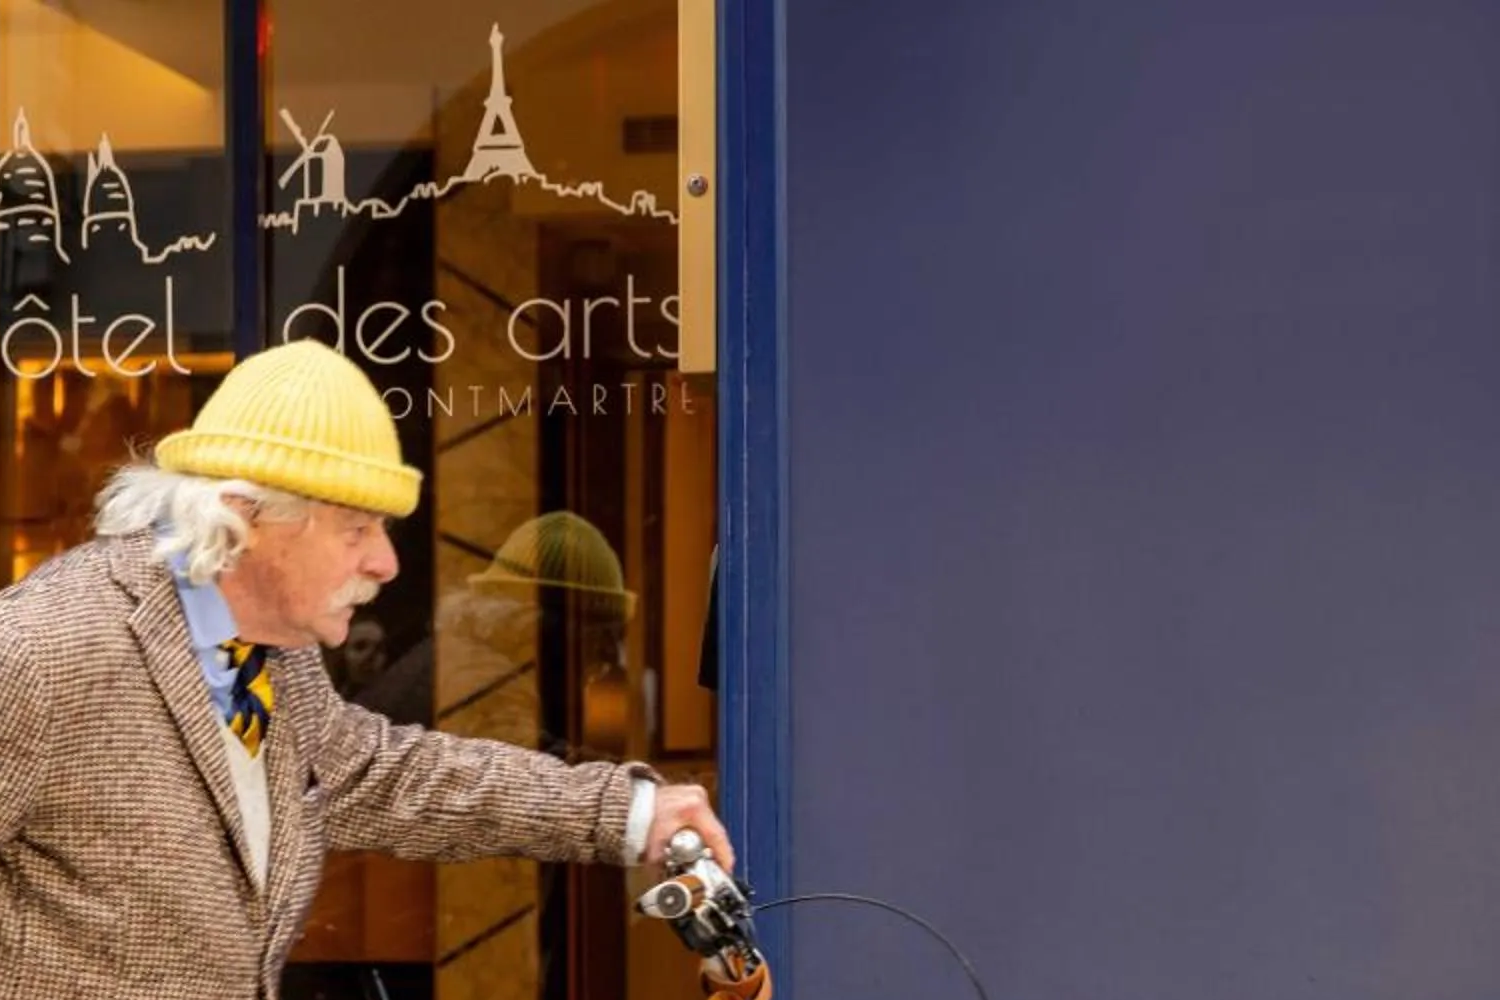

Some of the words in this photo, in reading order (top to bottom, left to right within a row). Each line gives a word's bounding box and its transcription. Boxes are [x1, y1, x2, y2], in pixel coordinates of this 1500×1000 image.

[283, 264, 456, 366] des
[506, 273, 680, 362] arts
[380, 381, 697, 420] ONTMARTRE
